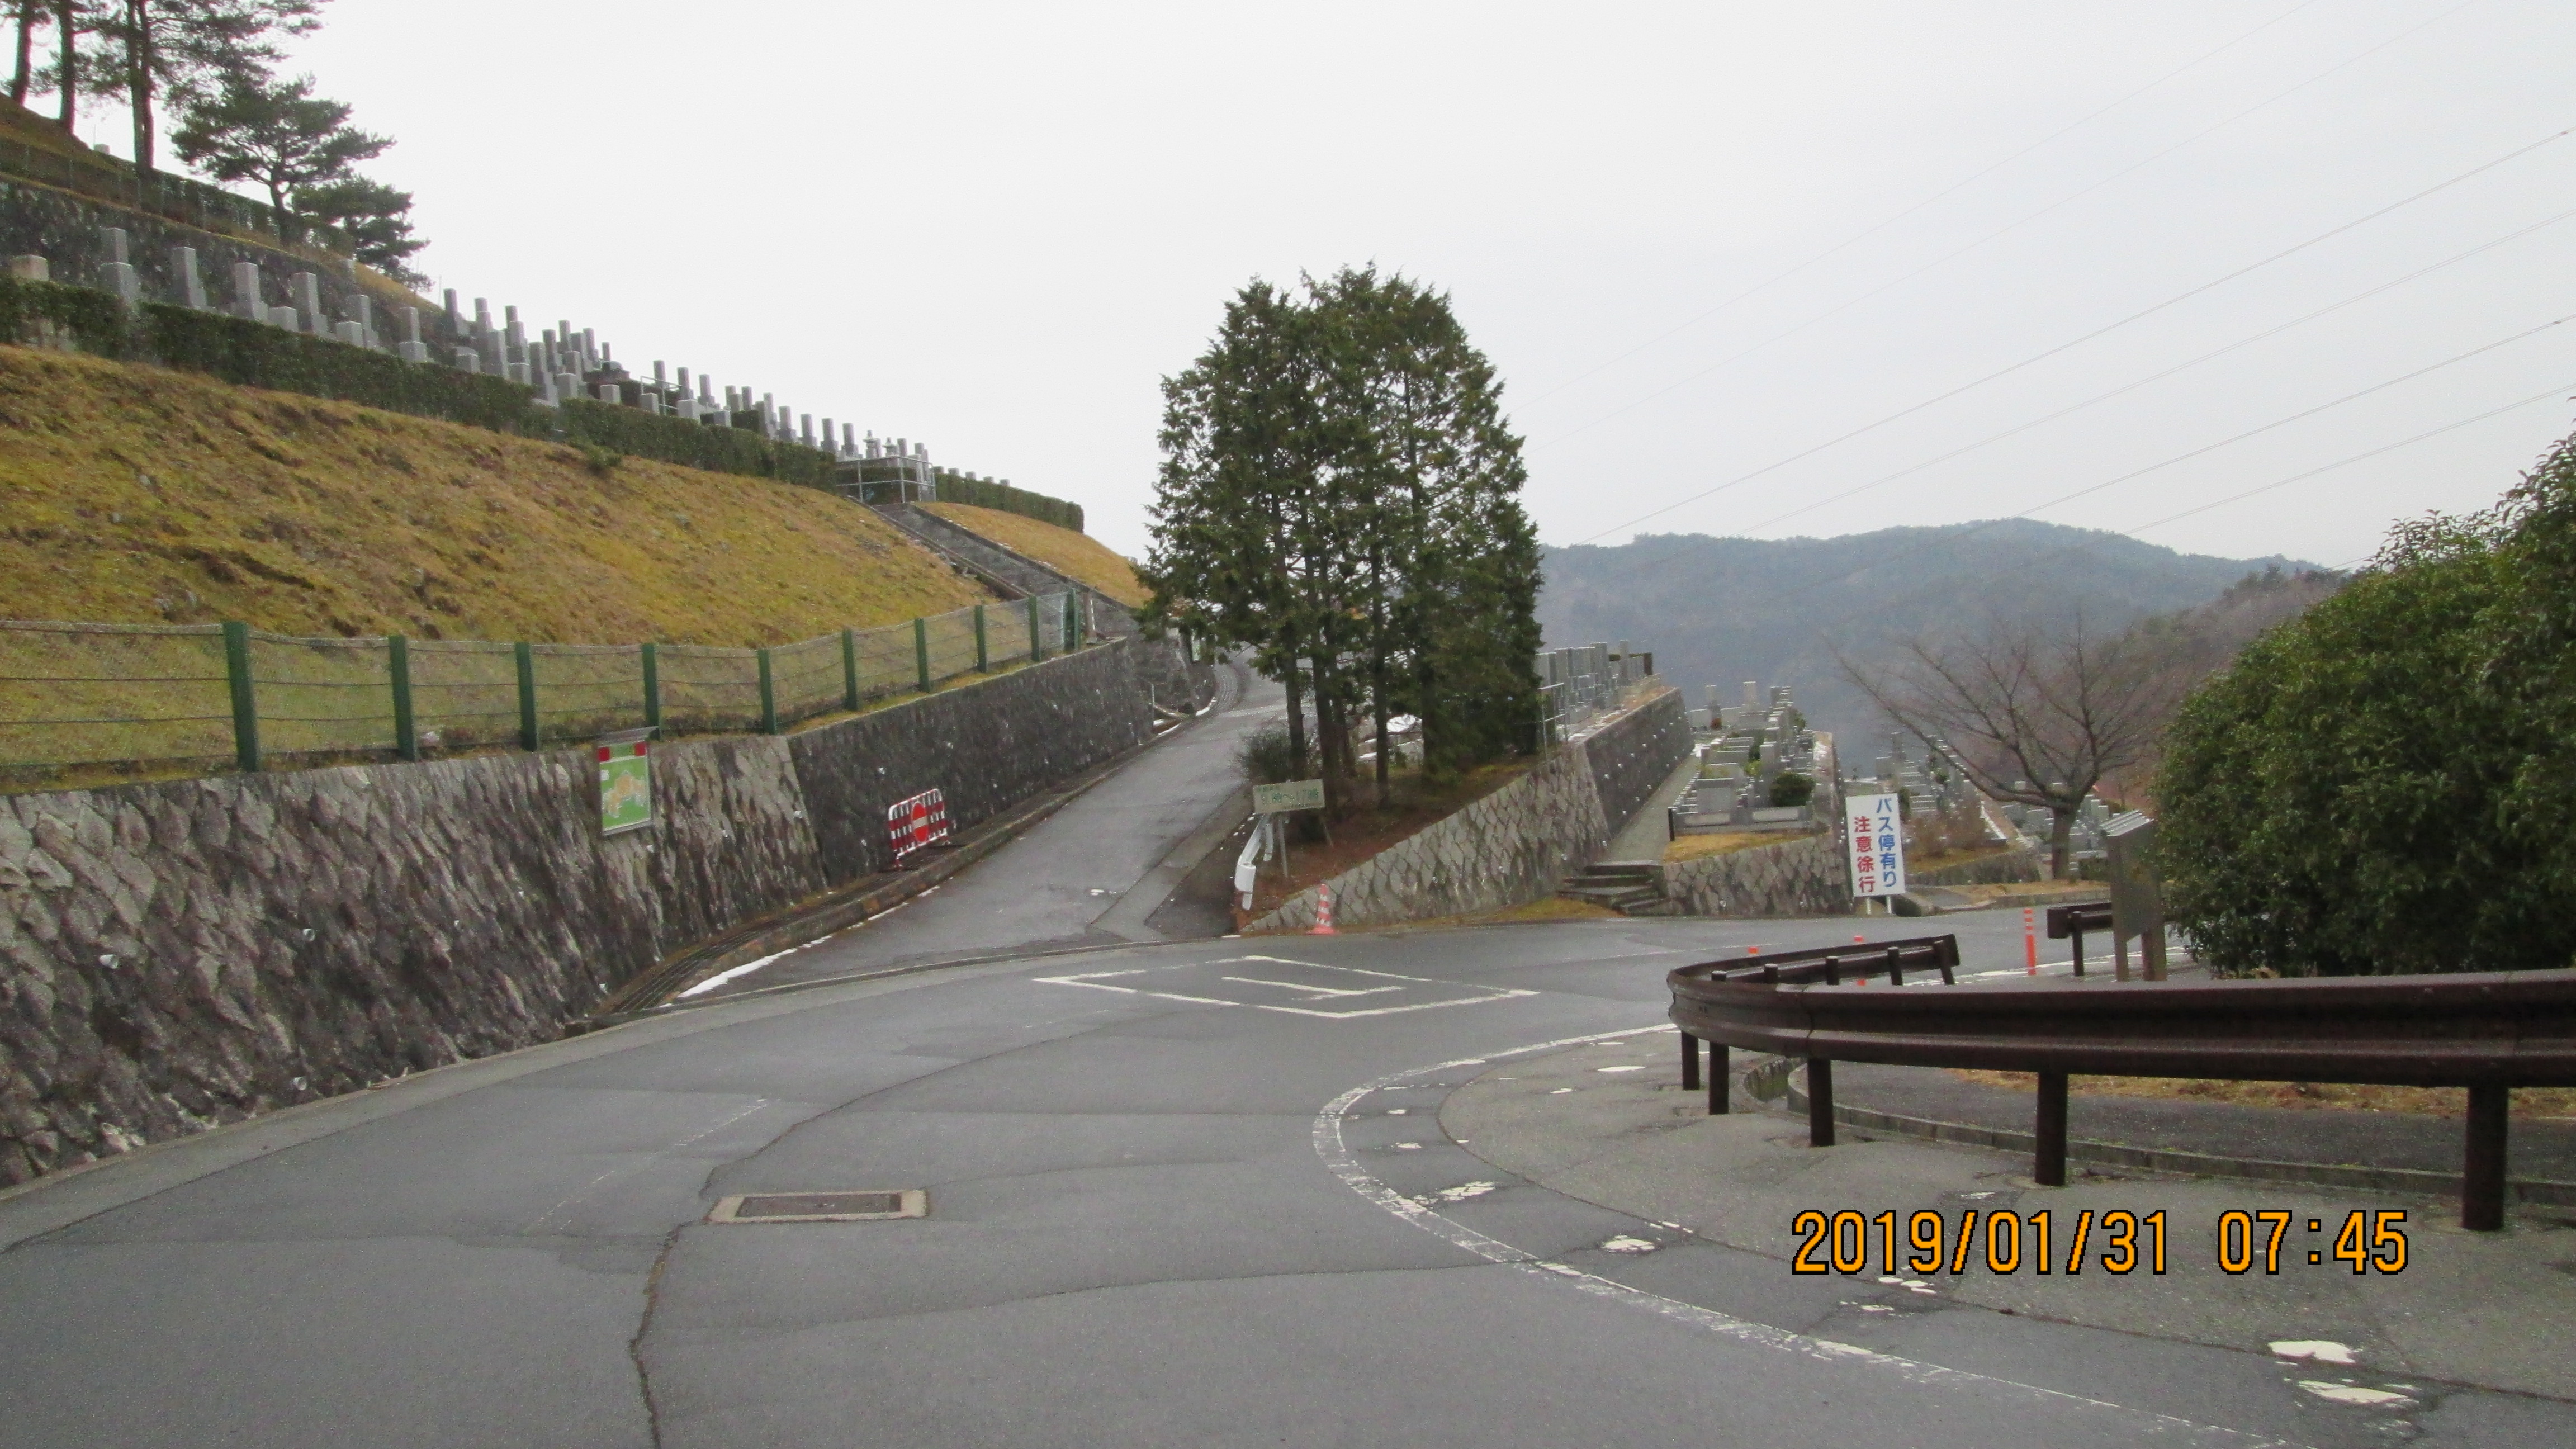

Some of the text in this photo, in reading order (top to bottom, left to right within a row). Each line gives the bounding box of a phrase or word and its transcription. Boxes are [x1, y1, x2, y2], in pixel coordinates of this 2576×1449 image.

[1854, 816, 1876, 893] 注意徐行
[1876, 798, 1897, 888] バス停有り
